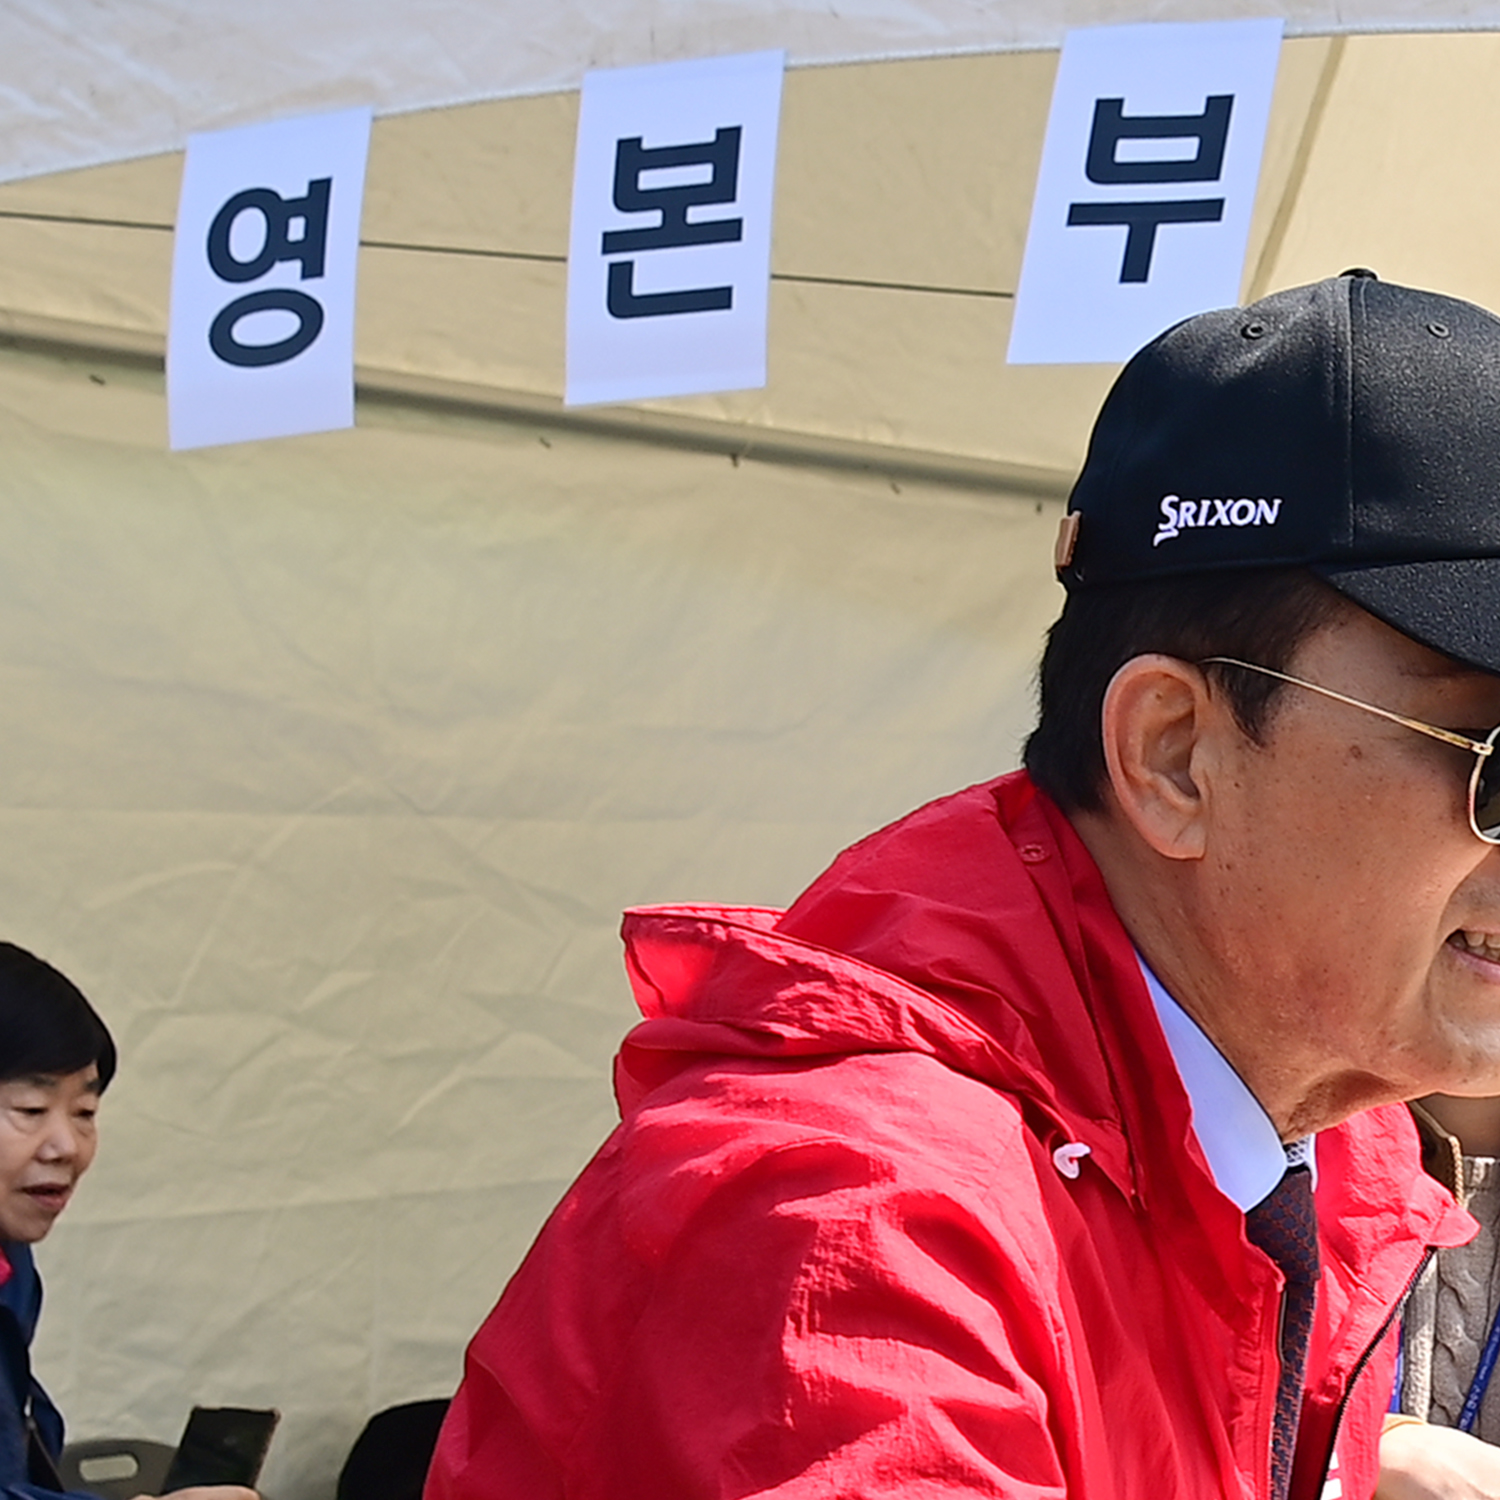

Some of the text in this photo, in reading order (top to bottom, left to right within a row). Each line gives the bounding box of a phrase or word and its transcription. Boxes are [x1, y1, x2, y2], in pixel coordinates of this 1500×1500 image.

[207, 94, 1235, 368] 영 본 부
[1153, 495, 1282, 546] SRIXON
